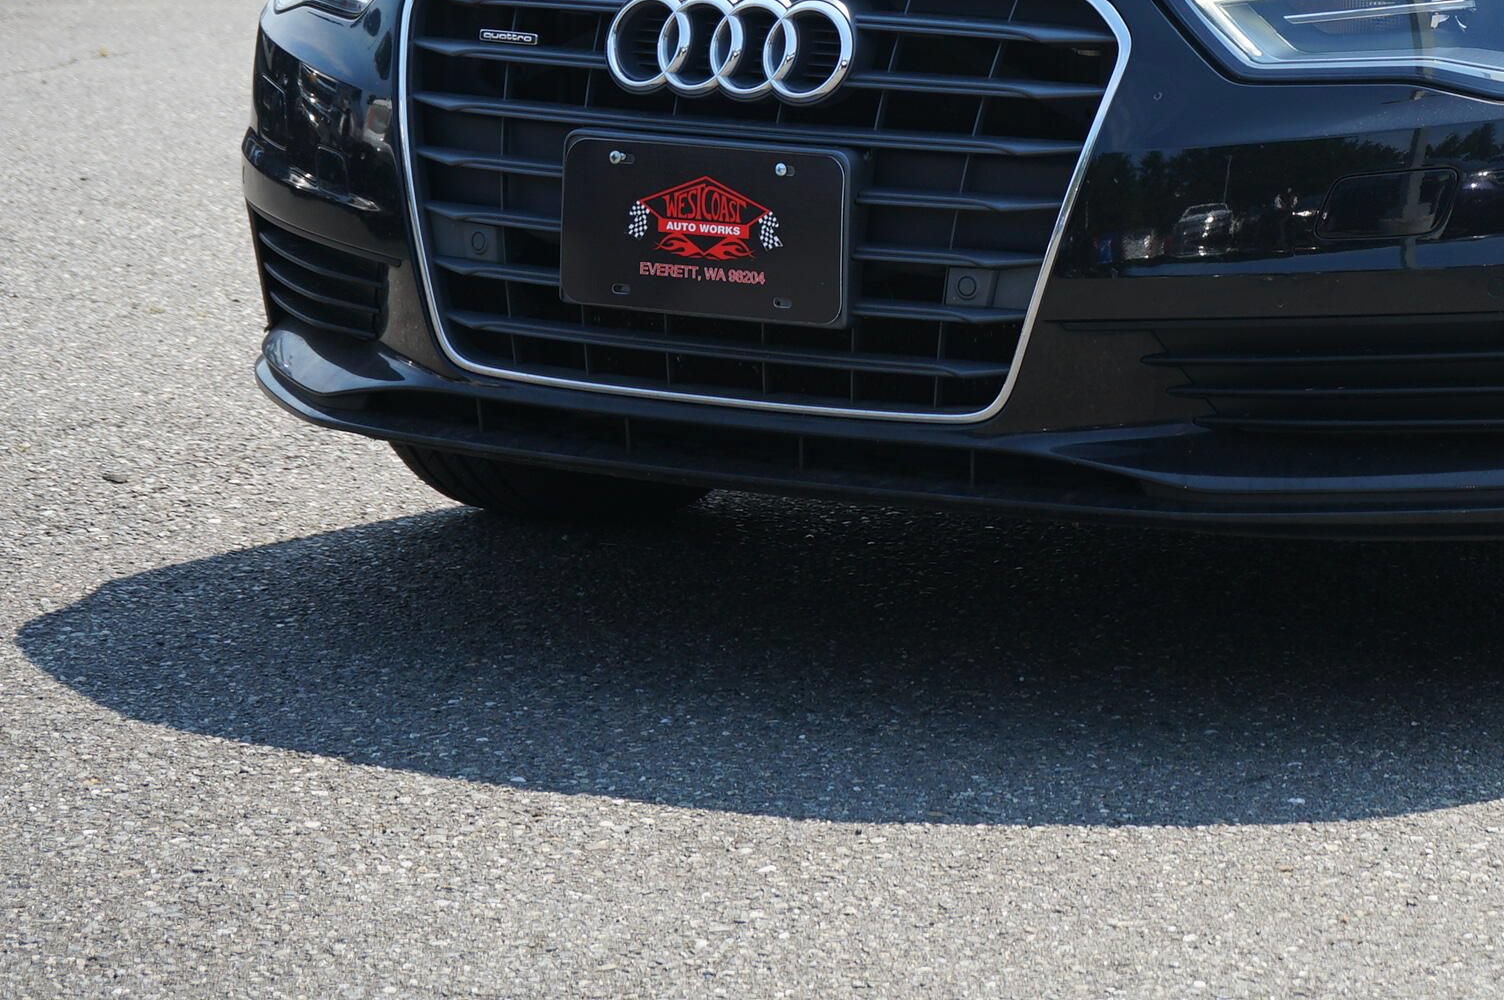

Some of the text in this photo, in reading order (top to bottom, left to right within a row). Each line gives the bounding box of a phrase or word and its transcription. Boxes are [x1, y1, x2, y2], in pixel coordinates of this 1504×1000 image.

[483, 32, 532, 42] quattro
[666, 221, 741, 236] AUTO WORKS
[639, 261, 701, 280] EVERETT,
[704, 267, 727, 282] WA
